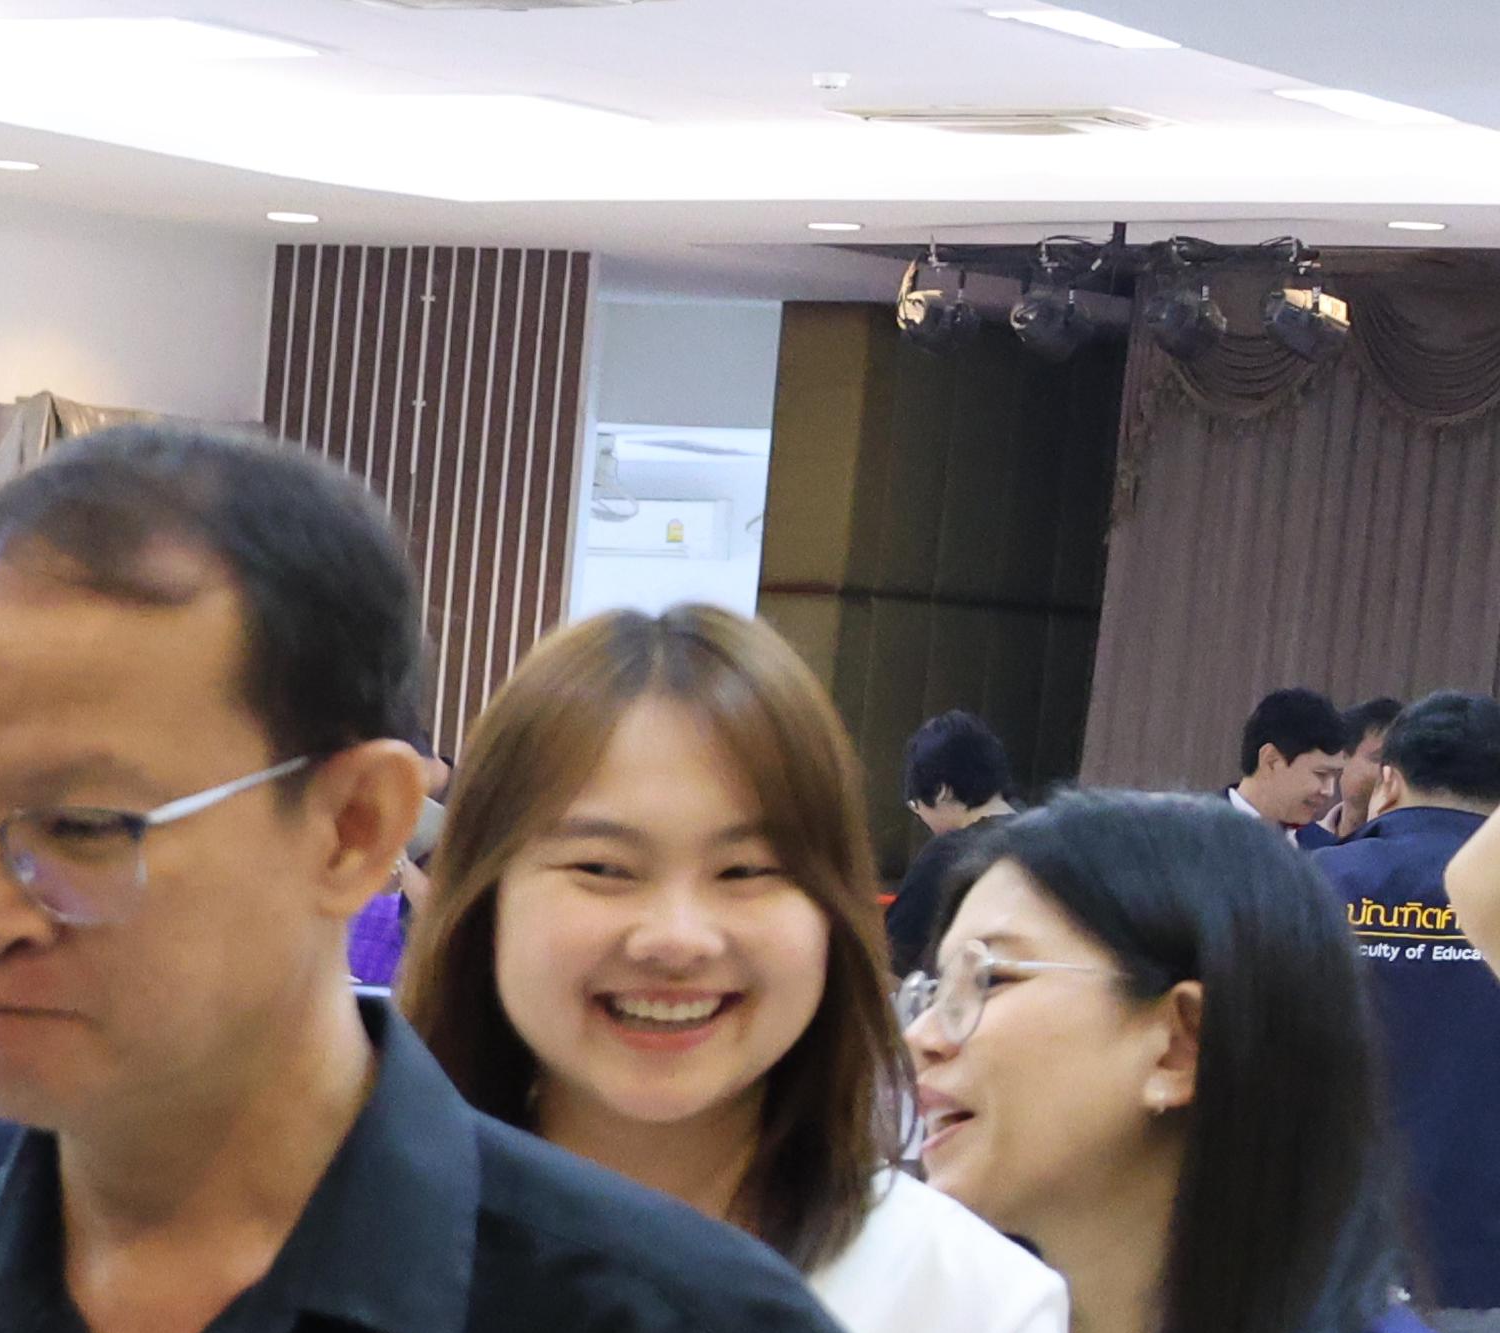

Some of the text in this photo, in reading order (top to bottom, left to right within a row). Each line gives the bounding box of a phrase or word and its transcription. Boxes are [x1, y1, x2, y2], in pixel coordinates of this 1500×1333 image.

[1357, 942, 1484, 962] culty of Educa
